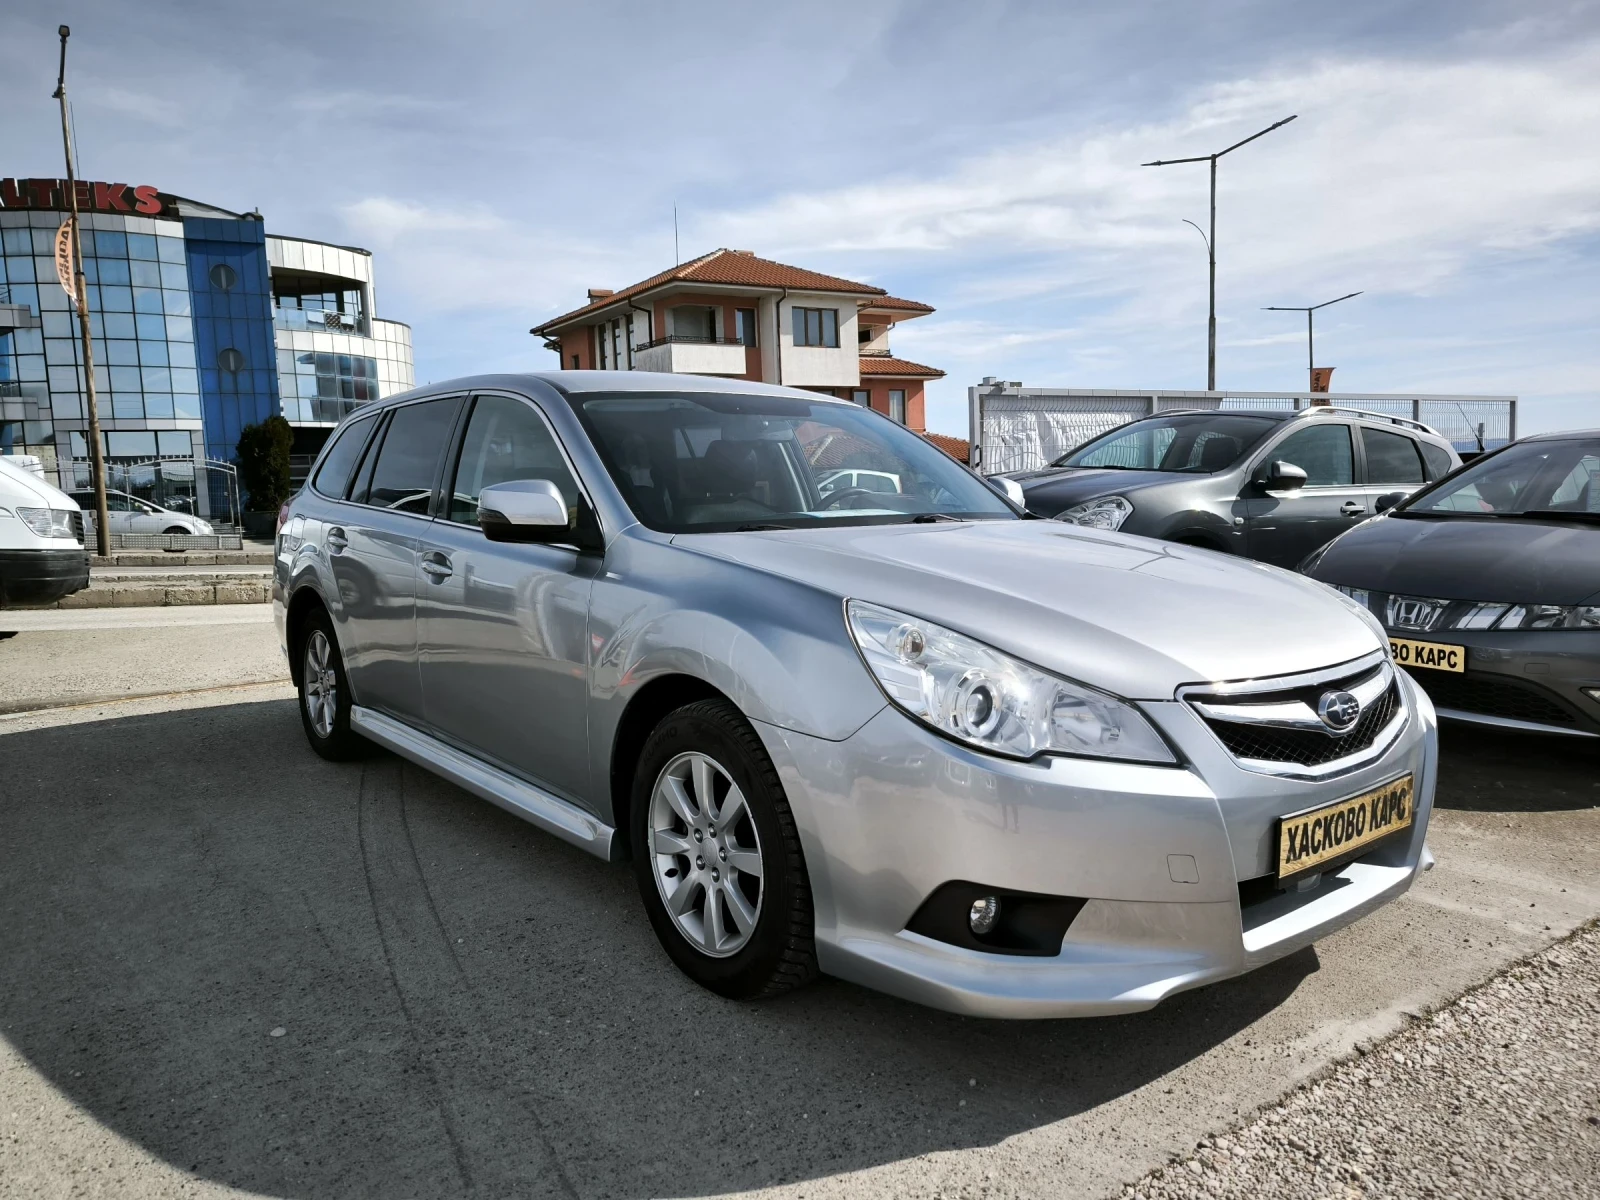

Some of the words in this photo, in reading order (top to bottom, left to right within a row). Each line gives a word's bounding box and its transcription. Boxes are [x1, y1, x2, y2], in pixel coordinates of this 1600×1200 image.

[0, 177, 162, 214] LTEKS
[1415, 646, 1457, 668] КАРС
[1286, 803, 1366, 864] ХАСКОВО
[1369, 788, 1407, 832] КАРС
